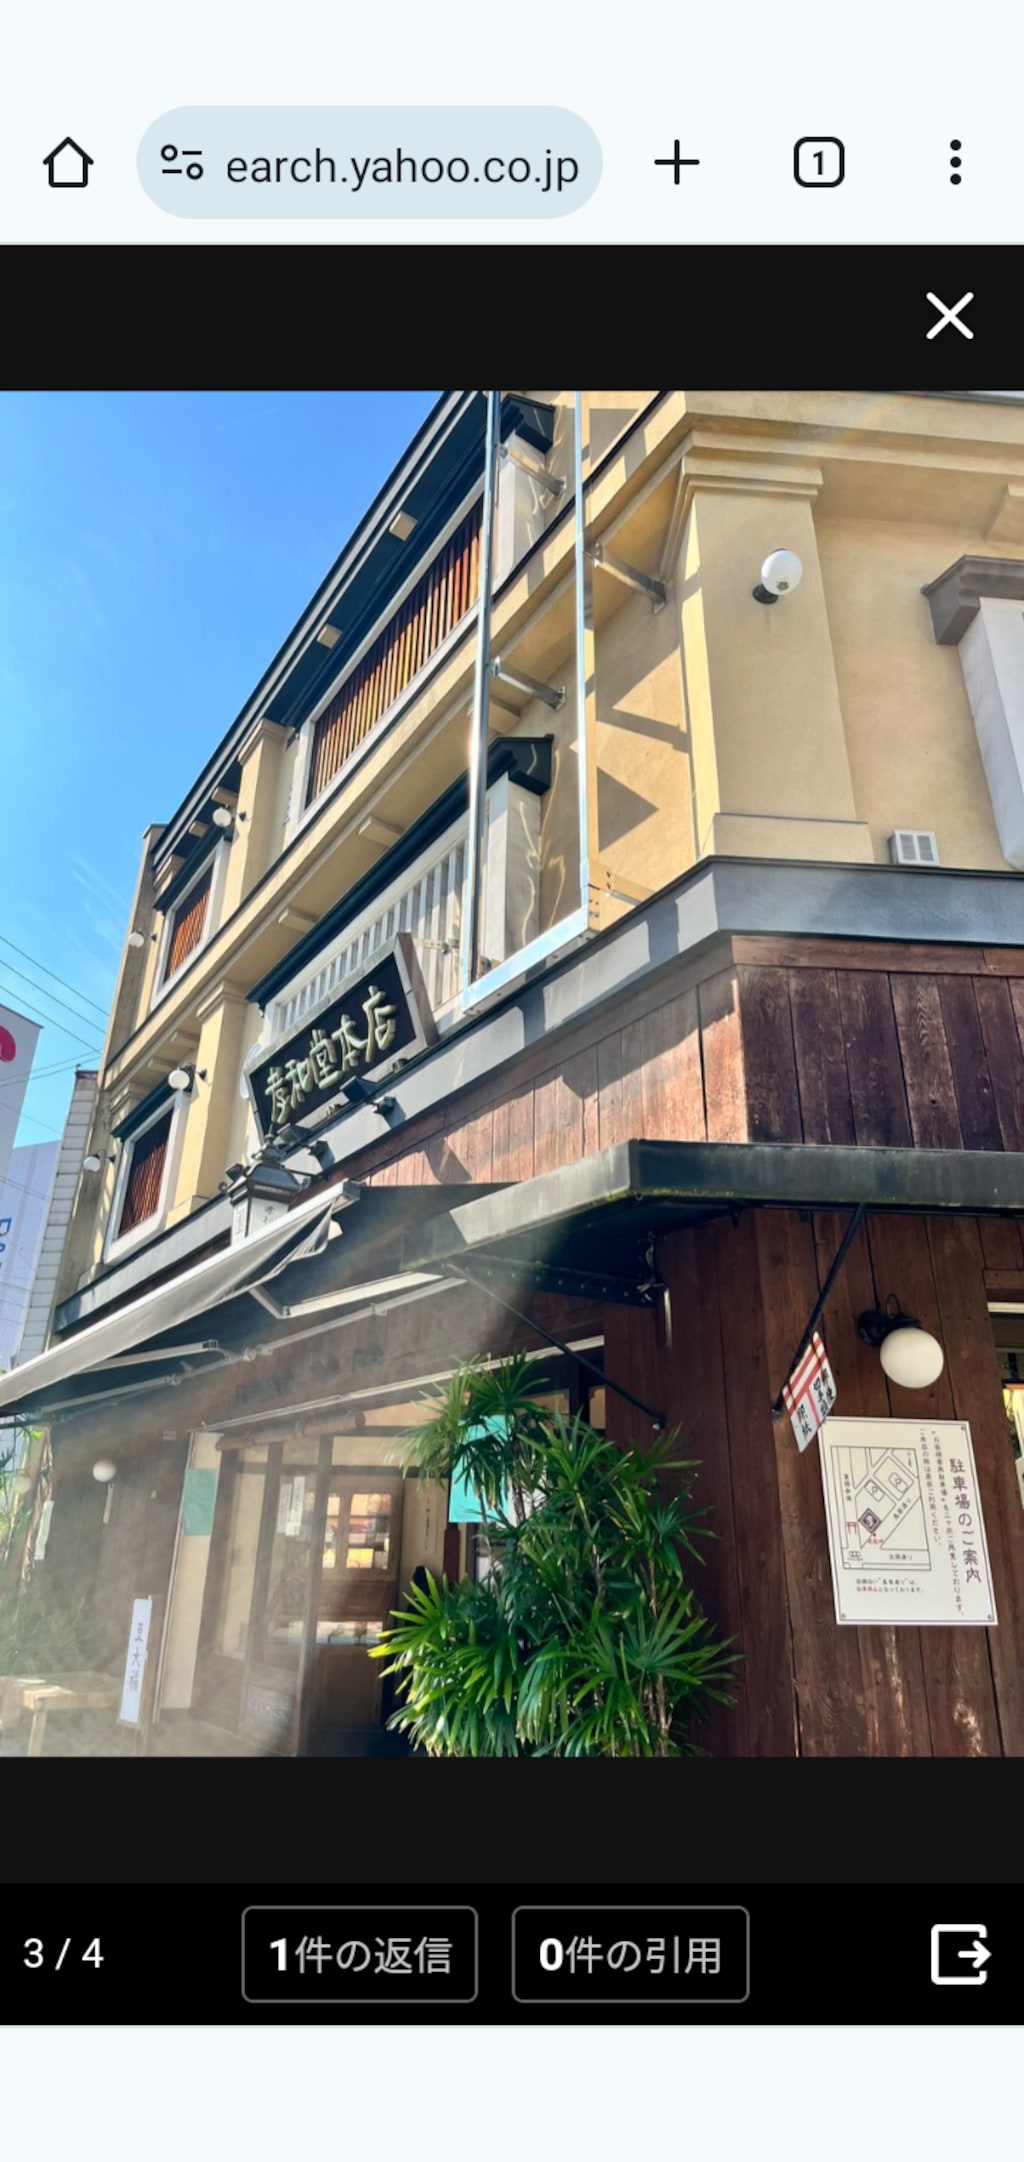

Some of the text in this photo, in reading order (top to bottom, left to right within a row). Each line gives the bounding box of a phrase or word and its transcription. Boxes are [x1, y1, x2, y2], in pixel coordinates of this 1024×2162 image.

[226, 148, 579, 191] earch.yahoo.co.jp
[812, 151, 824, 174] 1
[949, 1458, 982, 1584] 駐車場のご案内
[23, 1940, 104, 1971] 3 / 4
[268, 1935, 453, 1976] 1件の返信
[539, 1935, 723, 1976] 0件の引用
